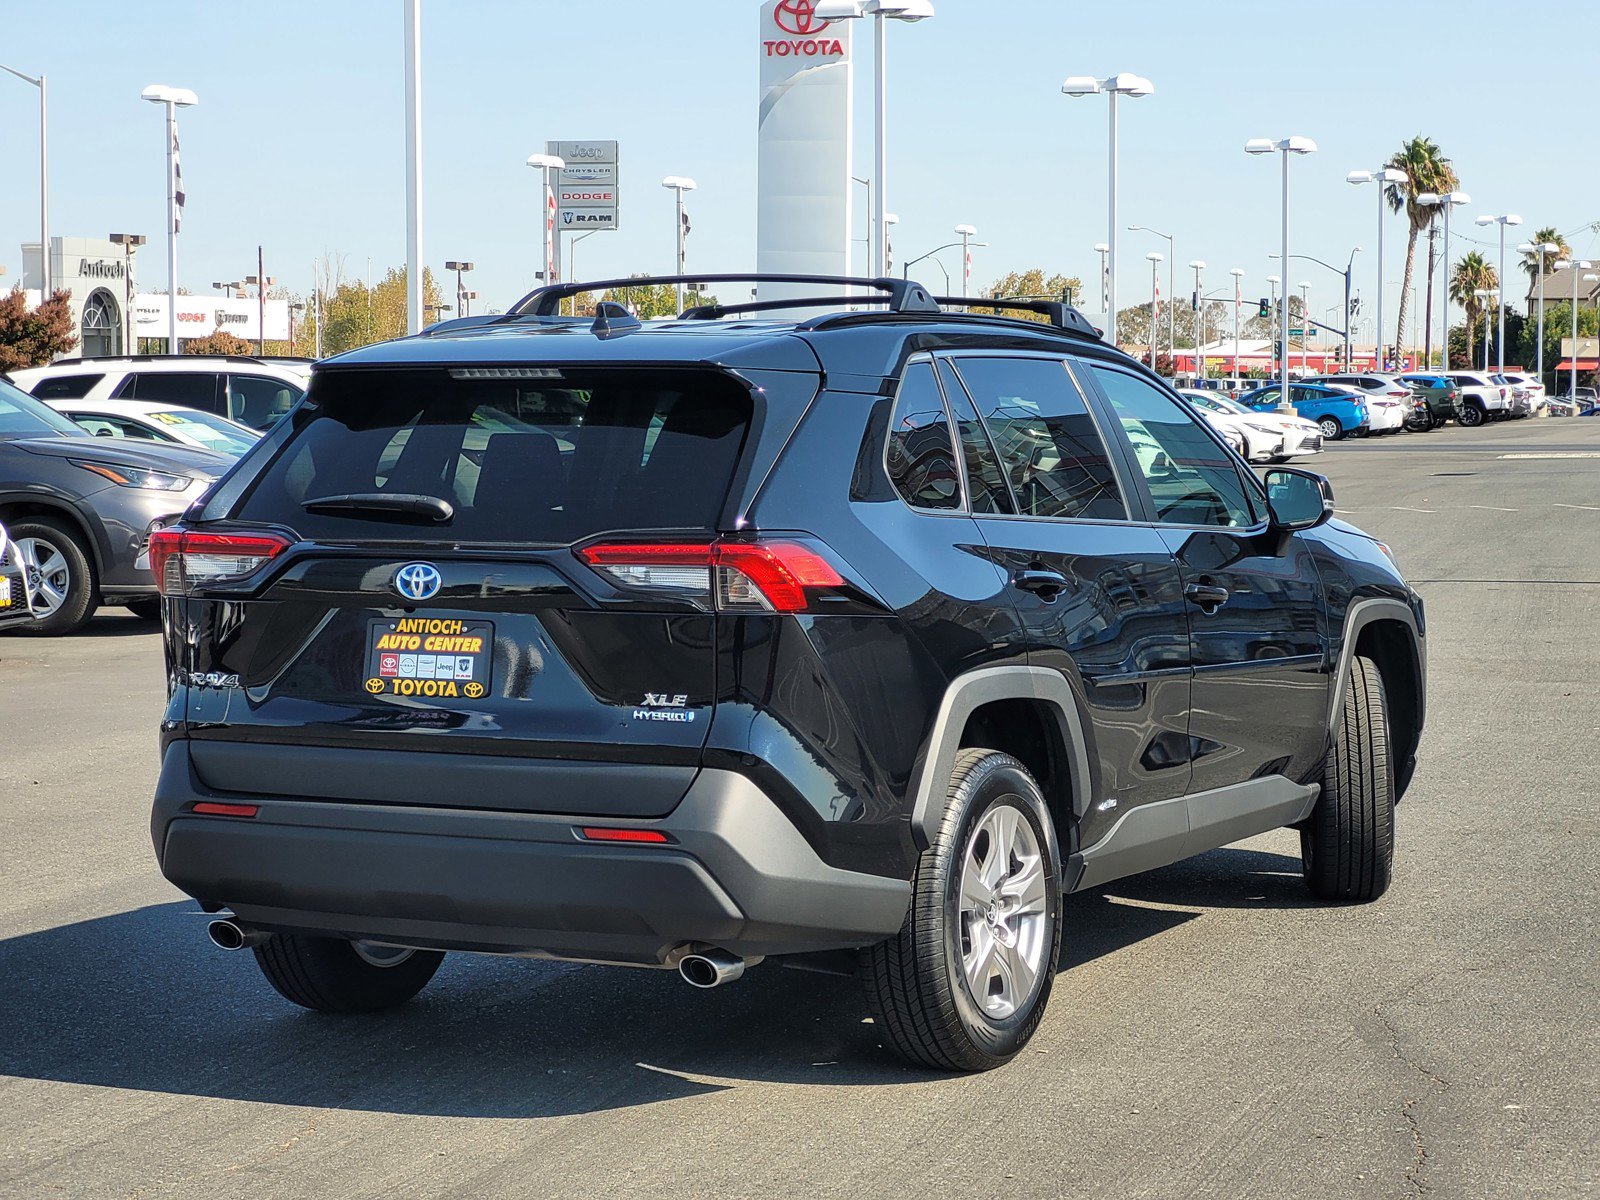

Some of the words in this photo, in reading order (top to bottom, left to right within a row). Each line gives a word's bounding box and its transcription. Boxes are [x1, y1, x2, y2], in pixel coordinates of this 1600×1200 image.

[763, 39, 844, 56] TOYOTA
[570, 145, 604, 160] Jeep
[79, 259, 125, 279] Antioch
[396, 618, 462, 635] ANTIOCH
[376, 634, 421, 650] AUTO
[424, 636, 482, 652] CENTER
[437, 663, 453, 671] Jeep
[189, 672, 239, 688] RAV4
[393, 679, 458, 697] TOYOTA
[641, 693, 688, 706] XLE
[633, 710, 686, 722] HYBRID
